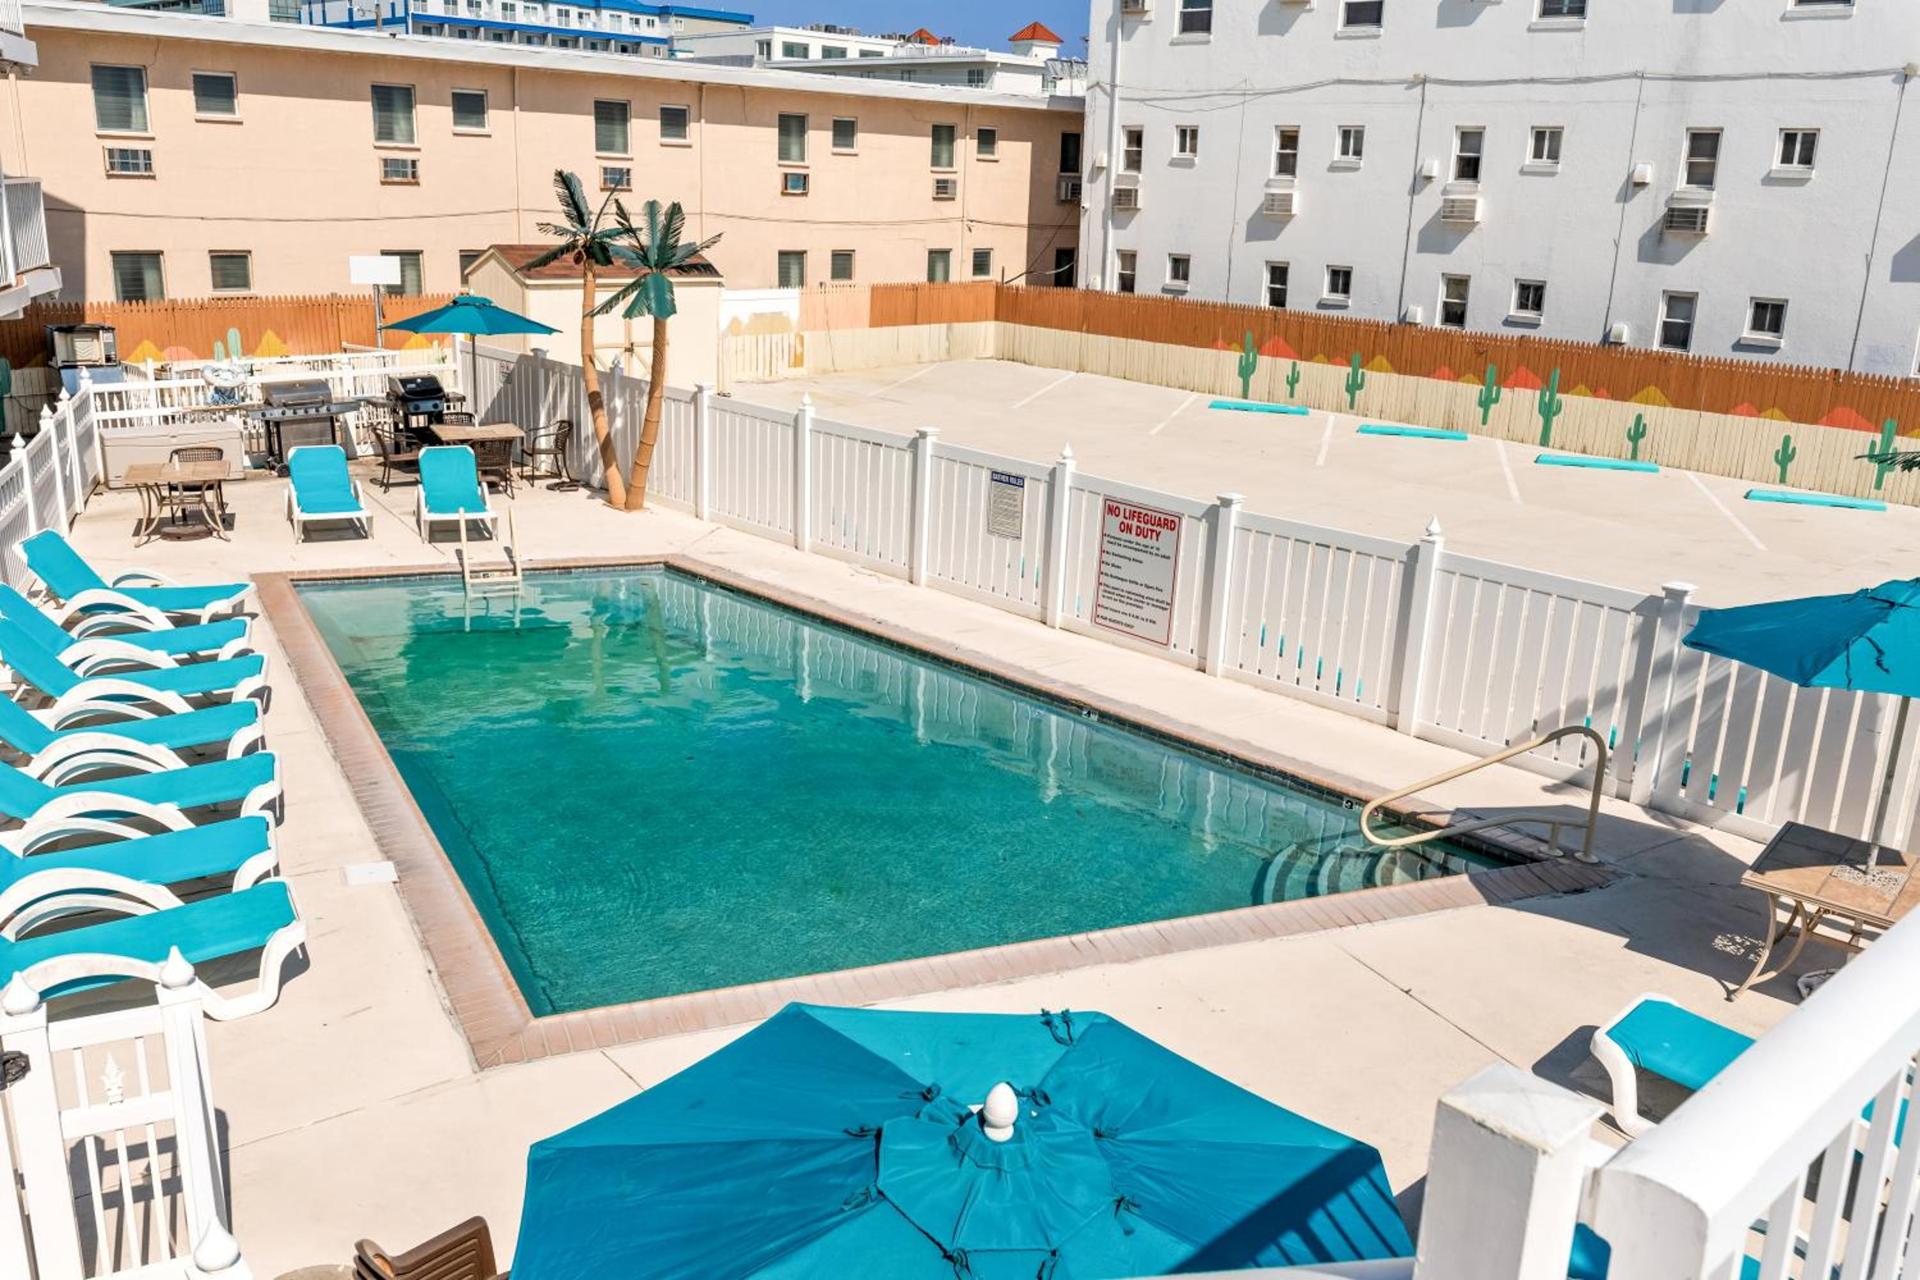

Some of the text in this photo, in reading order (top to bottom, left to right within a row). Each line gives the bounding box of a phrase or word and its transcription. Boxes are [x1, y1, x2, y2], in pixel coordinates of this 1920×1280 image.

[1106, 504, 1176, 531] NO LIFEGUARD
[1119, 521, 1132, 534] ON
[1135, 525, 1161, 542] DUTY
